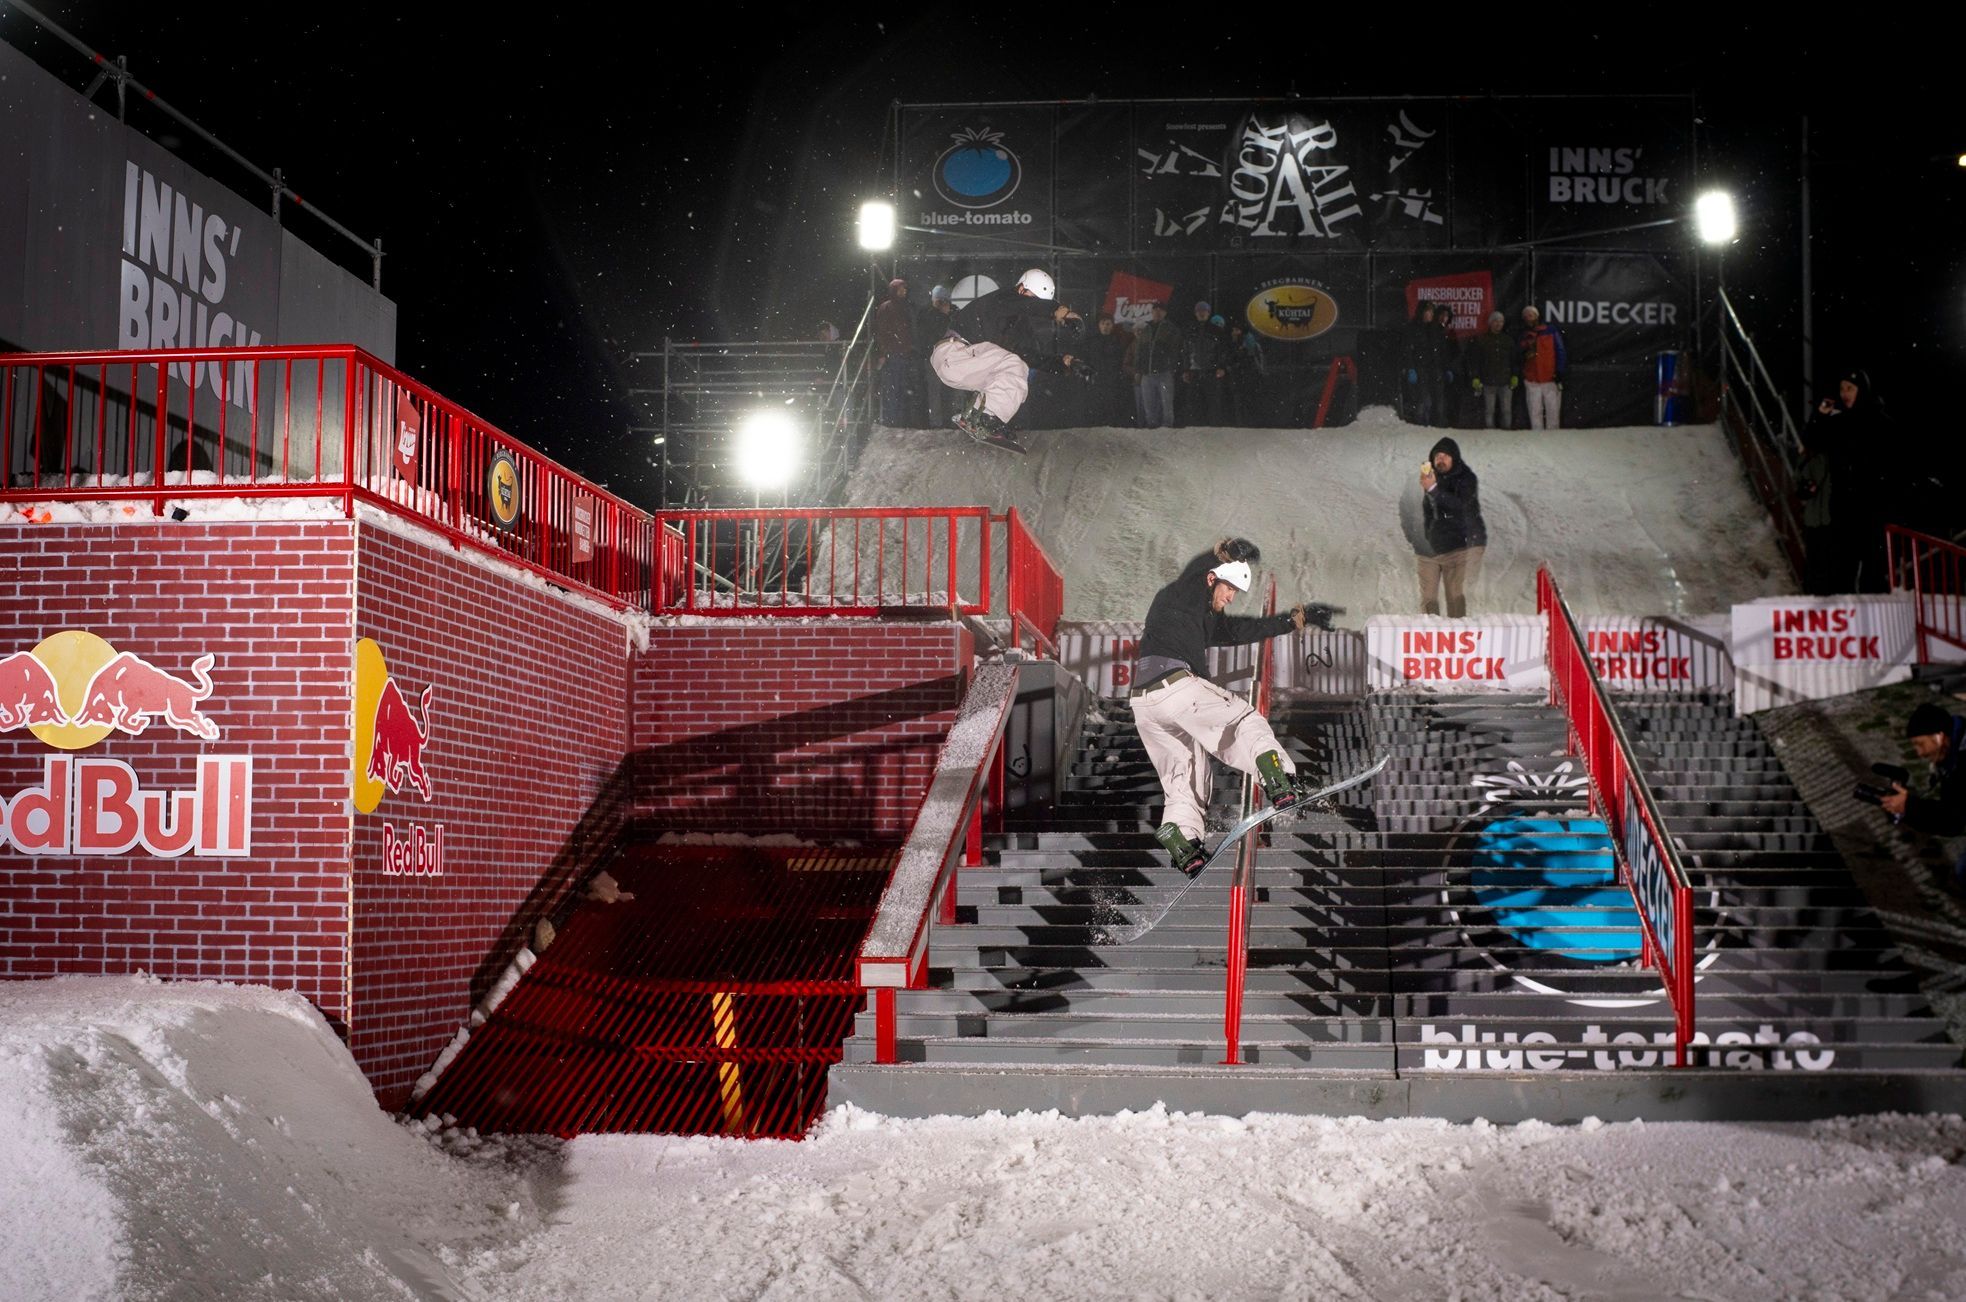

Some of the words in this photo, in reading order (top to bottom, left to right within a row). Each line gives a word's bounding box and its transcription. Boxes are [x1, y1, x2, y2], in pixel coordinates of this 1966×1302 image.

[1550, 147, 1642, 174] INNS'
[1219, 112, 1288, 229] ROCK
[1288, 119, 1363, 238] RAIL
[1550, 176, 1669, 204] BRUCK
[921, 210, 1032, 225] blue-tomato
[122, 159, 241, 304] INNS'
[1417, 287, 1483, 300] INNSBRUCKER
[1546, 301, 1677, 325] NIDECKER
[118, 259, 261, 414] BRUCK
[1773, 610, 1856, 633] INNS'
[1403, 631, 1482, 654] INNS'
[1588, 631, 1667, 653] INNS'
[1774, 636, 1880, 660] BRUCK
[1403, 657, 1505, 680] BRUCK
[383, 823, 414, 876] Red
[415, 825, 444, 877] Bull
[1421, 1024, 1835, 1071] blue-tomato
